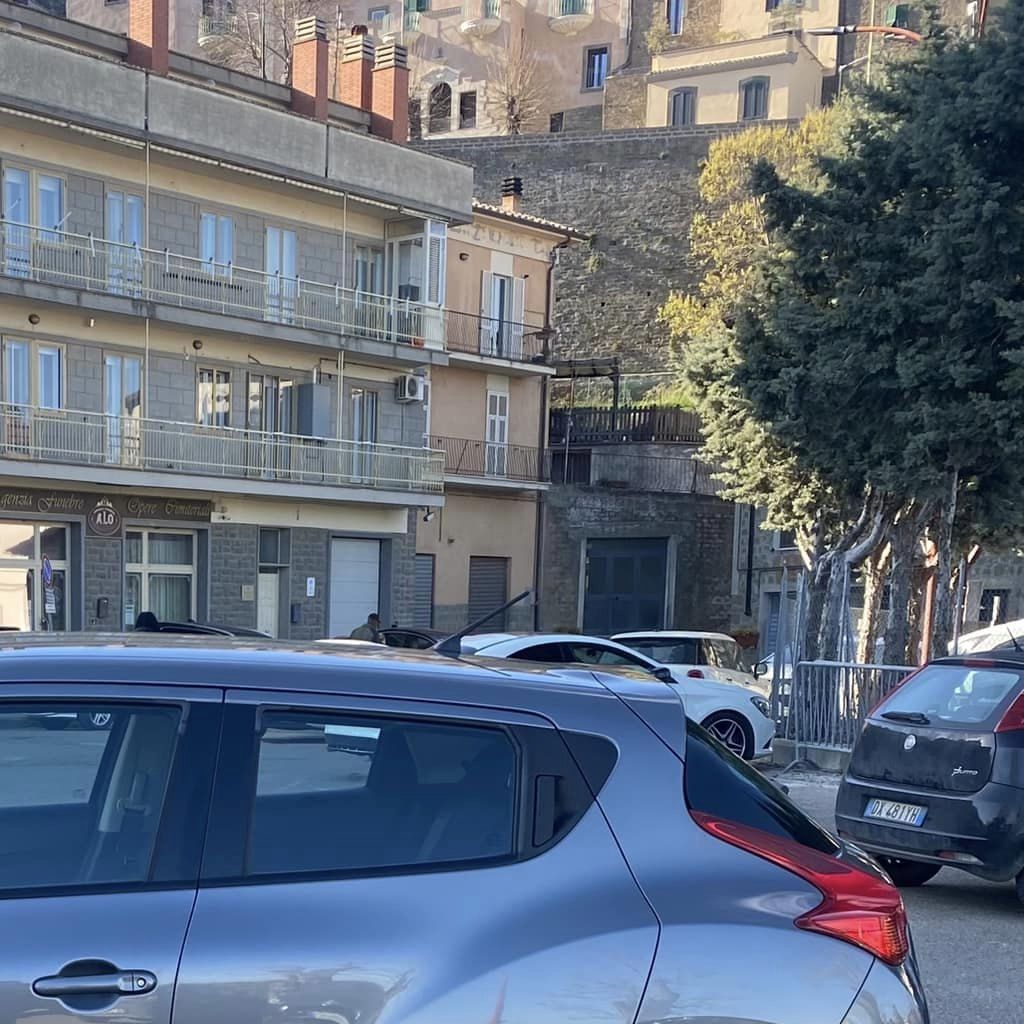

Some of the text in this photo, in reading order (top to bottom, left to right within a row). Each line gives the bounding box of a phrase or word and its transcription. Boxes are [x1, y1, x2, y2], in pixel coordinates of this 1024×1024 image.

[37, 491, 85, 512] Funebre
[127, 498, 156, 518] Opere
[96, 511, 114, 525] ALO
